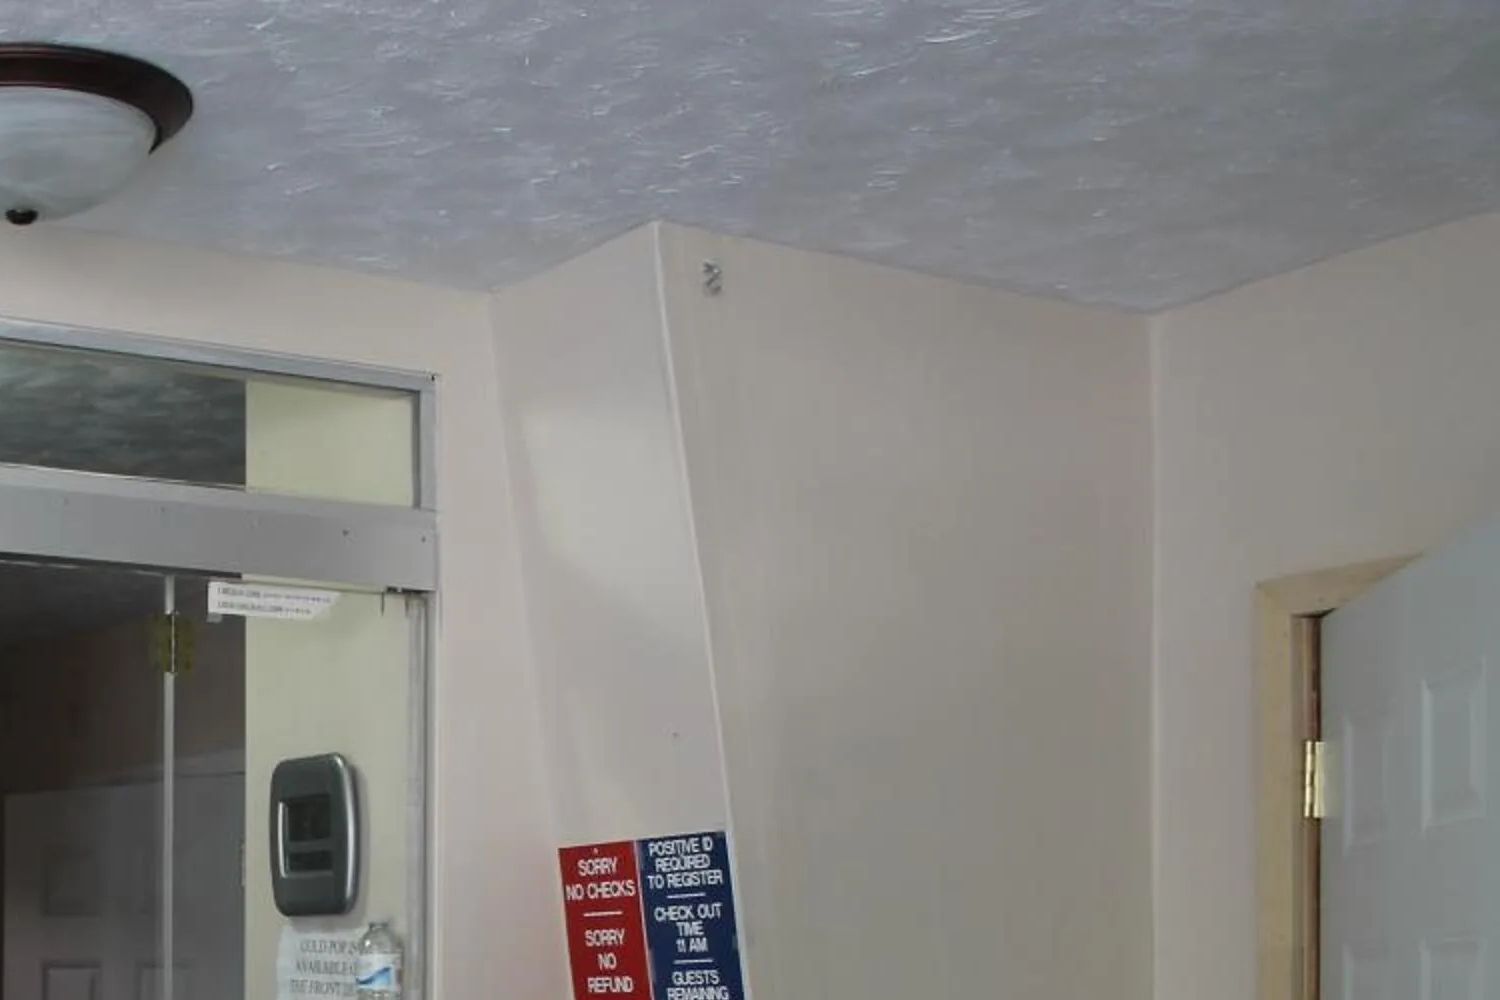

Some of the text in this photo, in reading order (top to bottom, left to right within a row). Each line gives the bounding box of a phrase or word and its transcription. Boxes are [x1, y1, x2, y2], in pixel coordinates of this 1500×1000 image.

[649, 837, 699, 857] POSITIVE
[578, 857, 618, 876] SORRY
[655, 852, 711, 873] REQUIRED
[648, 869, 723, 889] TO REGISTER
[565, 879, 636, 900] NO CHECKS
[654, 902, 722, 921] CHECK OUT
[585, 928, 625, 947] SORRY
[677, 921, 704, 937] TIME
[676, 937, 708, 953] 11 AM
[598, 952, 617, 970] NO
[587, 976, 634, 993] REFUND
[672, 969, 720, 985] GUESTS
[667, 986, 729, 1000] REMAINING
